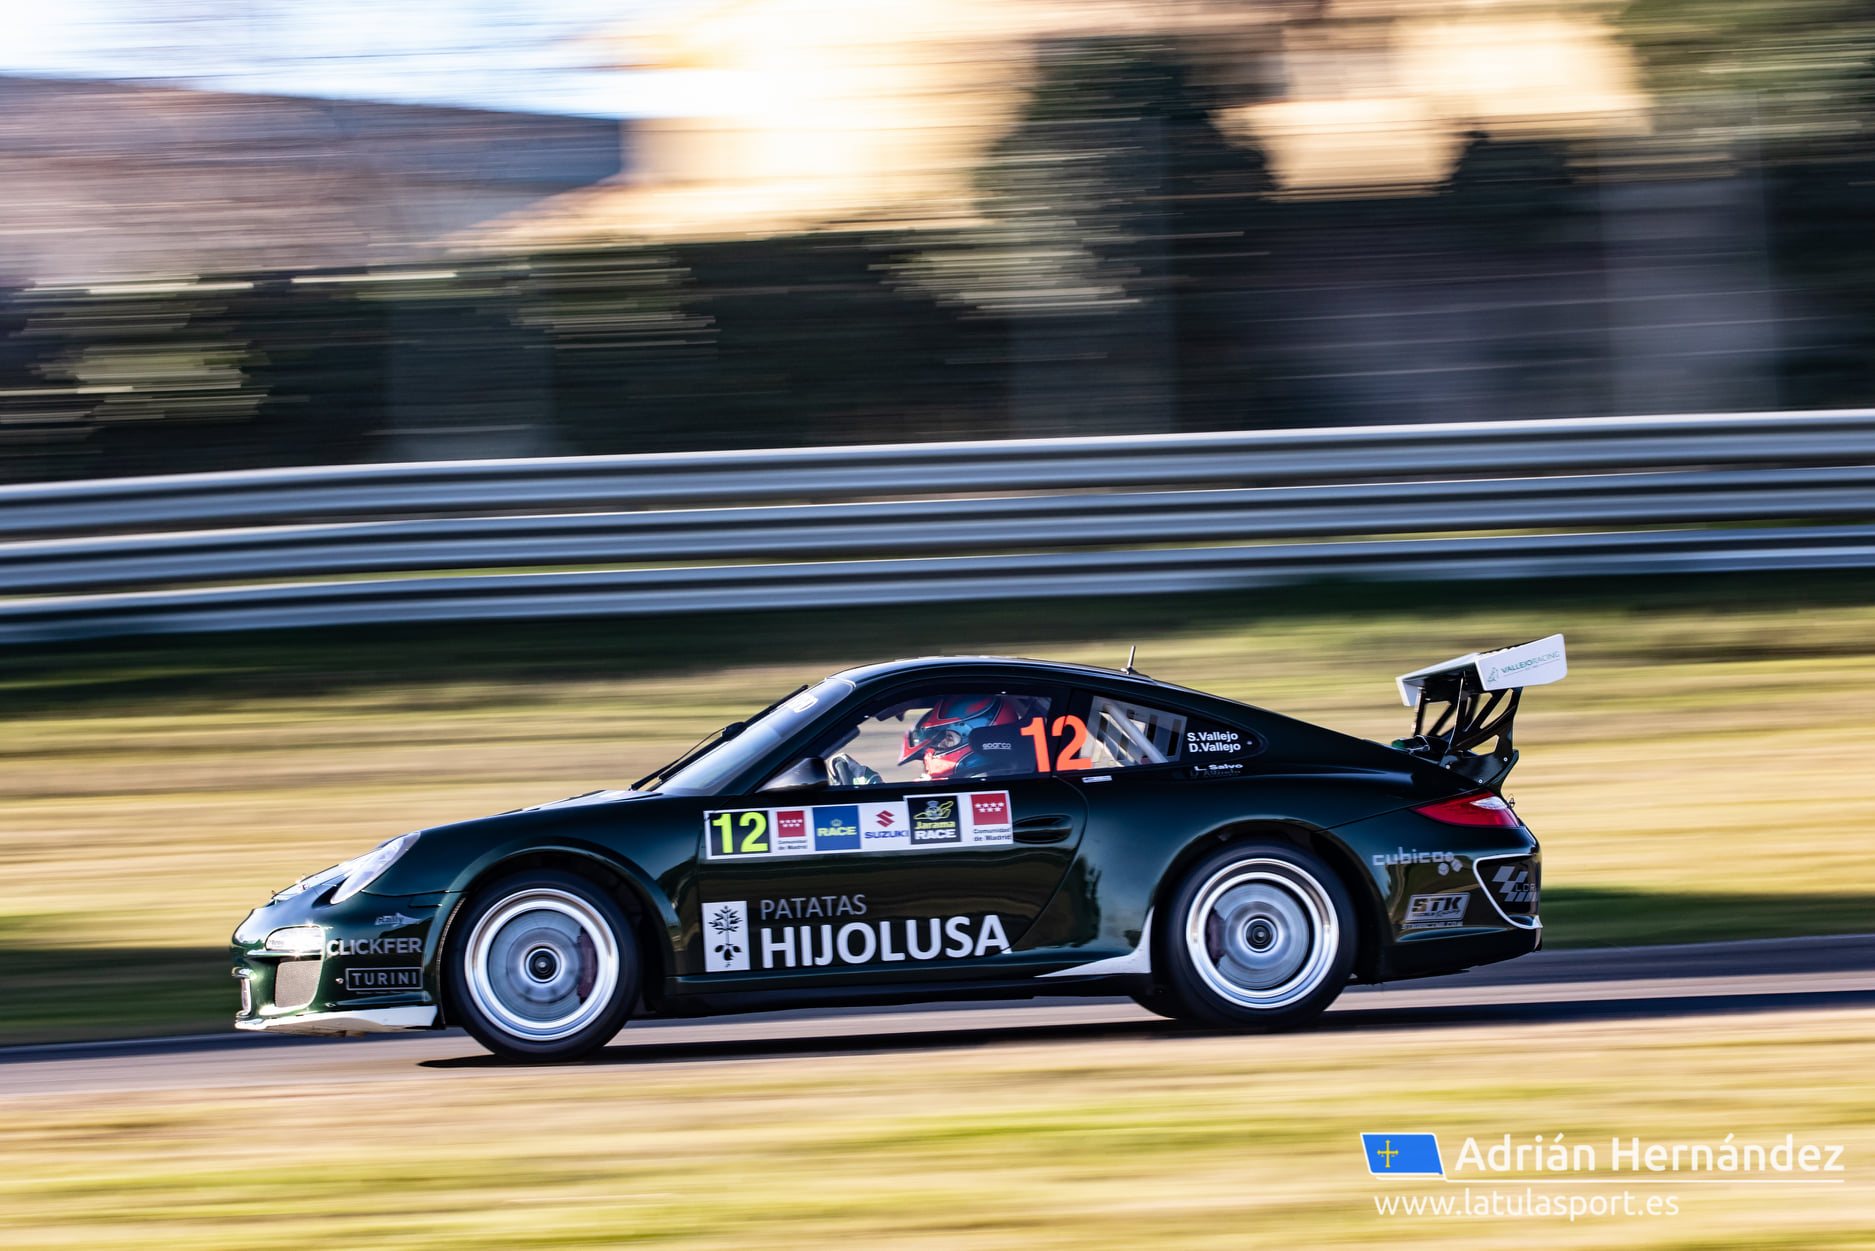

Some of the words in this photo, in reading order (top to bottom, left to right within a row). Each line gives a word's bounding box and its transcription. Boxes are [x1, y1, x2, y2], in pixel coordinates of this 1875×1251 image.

[1187, 731, 1239, 742] S.Vallejo
[1020, 715, 1093, 772] 12
[1188, 742, 1242, 753] D.Vallejo
[817, 826, 858, 837] RACE
[914, 821, 956, 830] Jarama
[712, 812, 768, 853] 12
[864, 830, 909, 839] SUZUKI
[914, 829, 957, 840] RACE
[761, 894, 868, 921] PATATAS
[1411, 896, 1462, 913] STK
[327, 938, 422, 955] CLICKFER
[760, 915, 1012, 968] HIJOLUSA
[352, 972, 417, 985] TURINI
